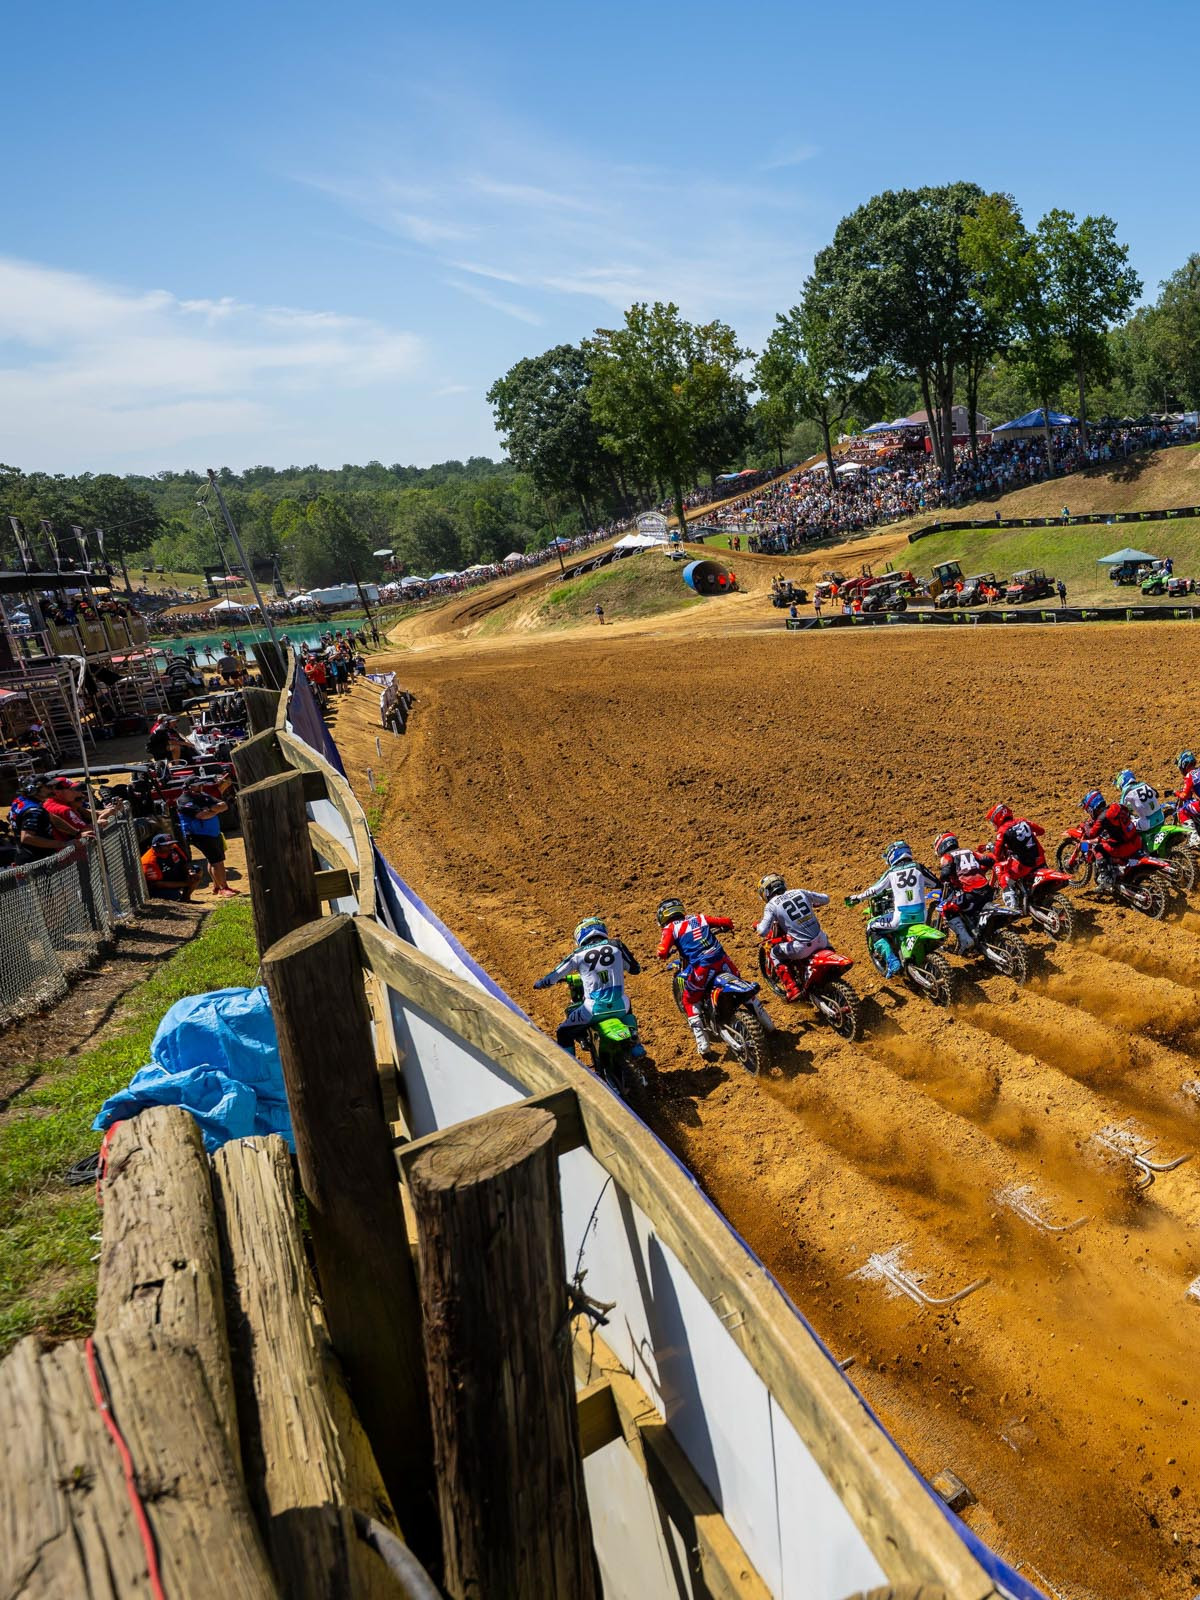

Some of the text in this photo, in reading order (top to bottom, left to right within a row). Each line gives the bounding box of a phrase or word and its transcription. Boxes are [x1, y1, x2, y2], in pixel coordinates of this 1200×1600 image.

[1136, 785, 1154, 802] 56
[959, 852, 980, 871] 44
[896, 869, 918, 889] 36
[782, 895, 811, 921] 25
[584, 945, 615, 972] 98
